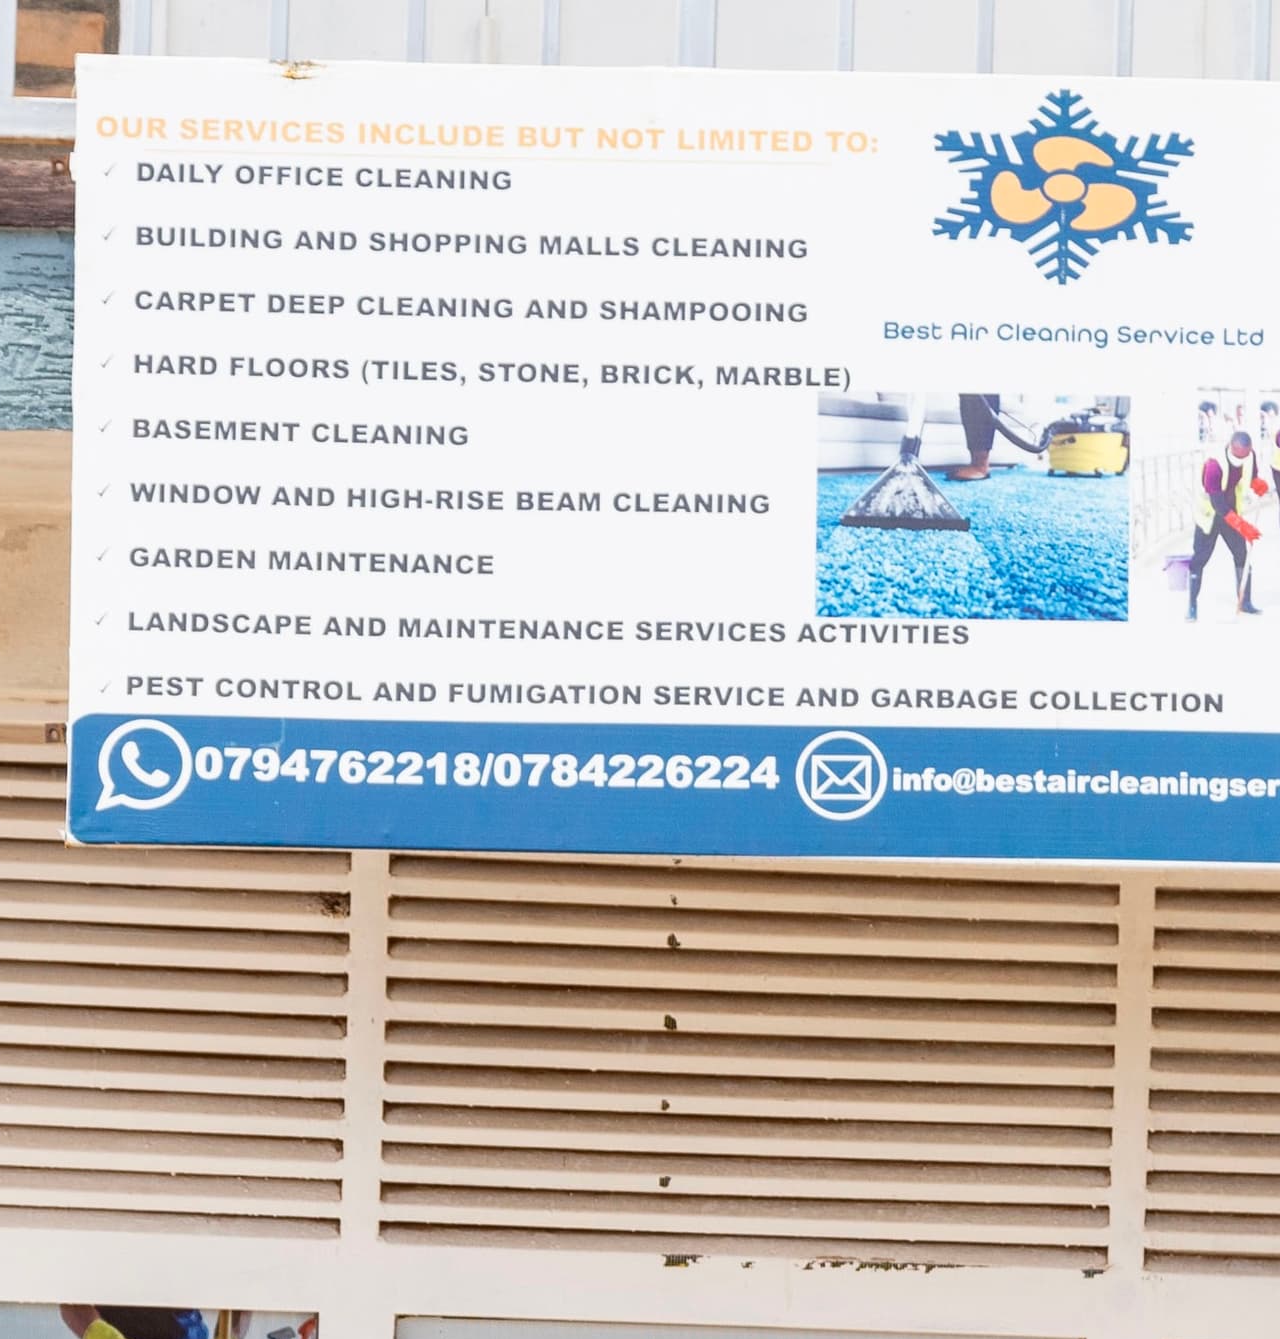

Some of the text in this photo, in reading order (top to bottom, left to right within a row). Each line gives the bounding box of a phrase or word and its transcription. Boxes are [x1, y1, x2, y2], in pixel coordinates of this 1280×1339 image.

[95, 115, 878, 154] OUR SERVICES INCLUDE BUT NOT LIMITED TO:
[137, 162, 512, 191] DAILY OFFICE CLEANING
[136, 226, 808, 259] BUILDING AND SHOPPING MALLS CLEANING
[134, 290, 808, 323] CARPET DEEP CLEANING AND SHAMPOOING
[883, 321, 1264, 349] Best Air Cleaning Service Ltd
[134, 354, 851, 393] HARD FLOORS (TILES, STONE, BRICK, MARBLE)
[132, 418, 468, 446] BASEMENT CLEANING
[130, 482, 770, 515] WINDOW AND HIGH-RISE BEAM CLEANING
[129, 547, 494, 575] GARDEN MAINTENANCE
[128, 611, 969, 645] LANDSCAPE AND MAINTENANCE SERVICES ACTIVITIES
[126, 676, 1223, 713] PEST CONTROL AND FUMIGATION SERVICE AND GARBAGE COLLECTION
[195, 747, 780, 790] 0794762218/0784226224
